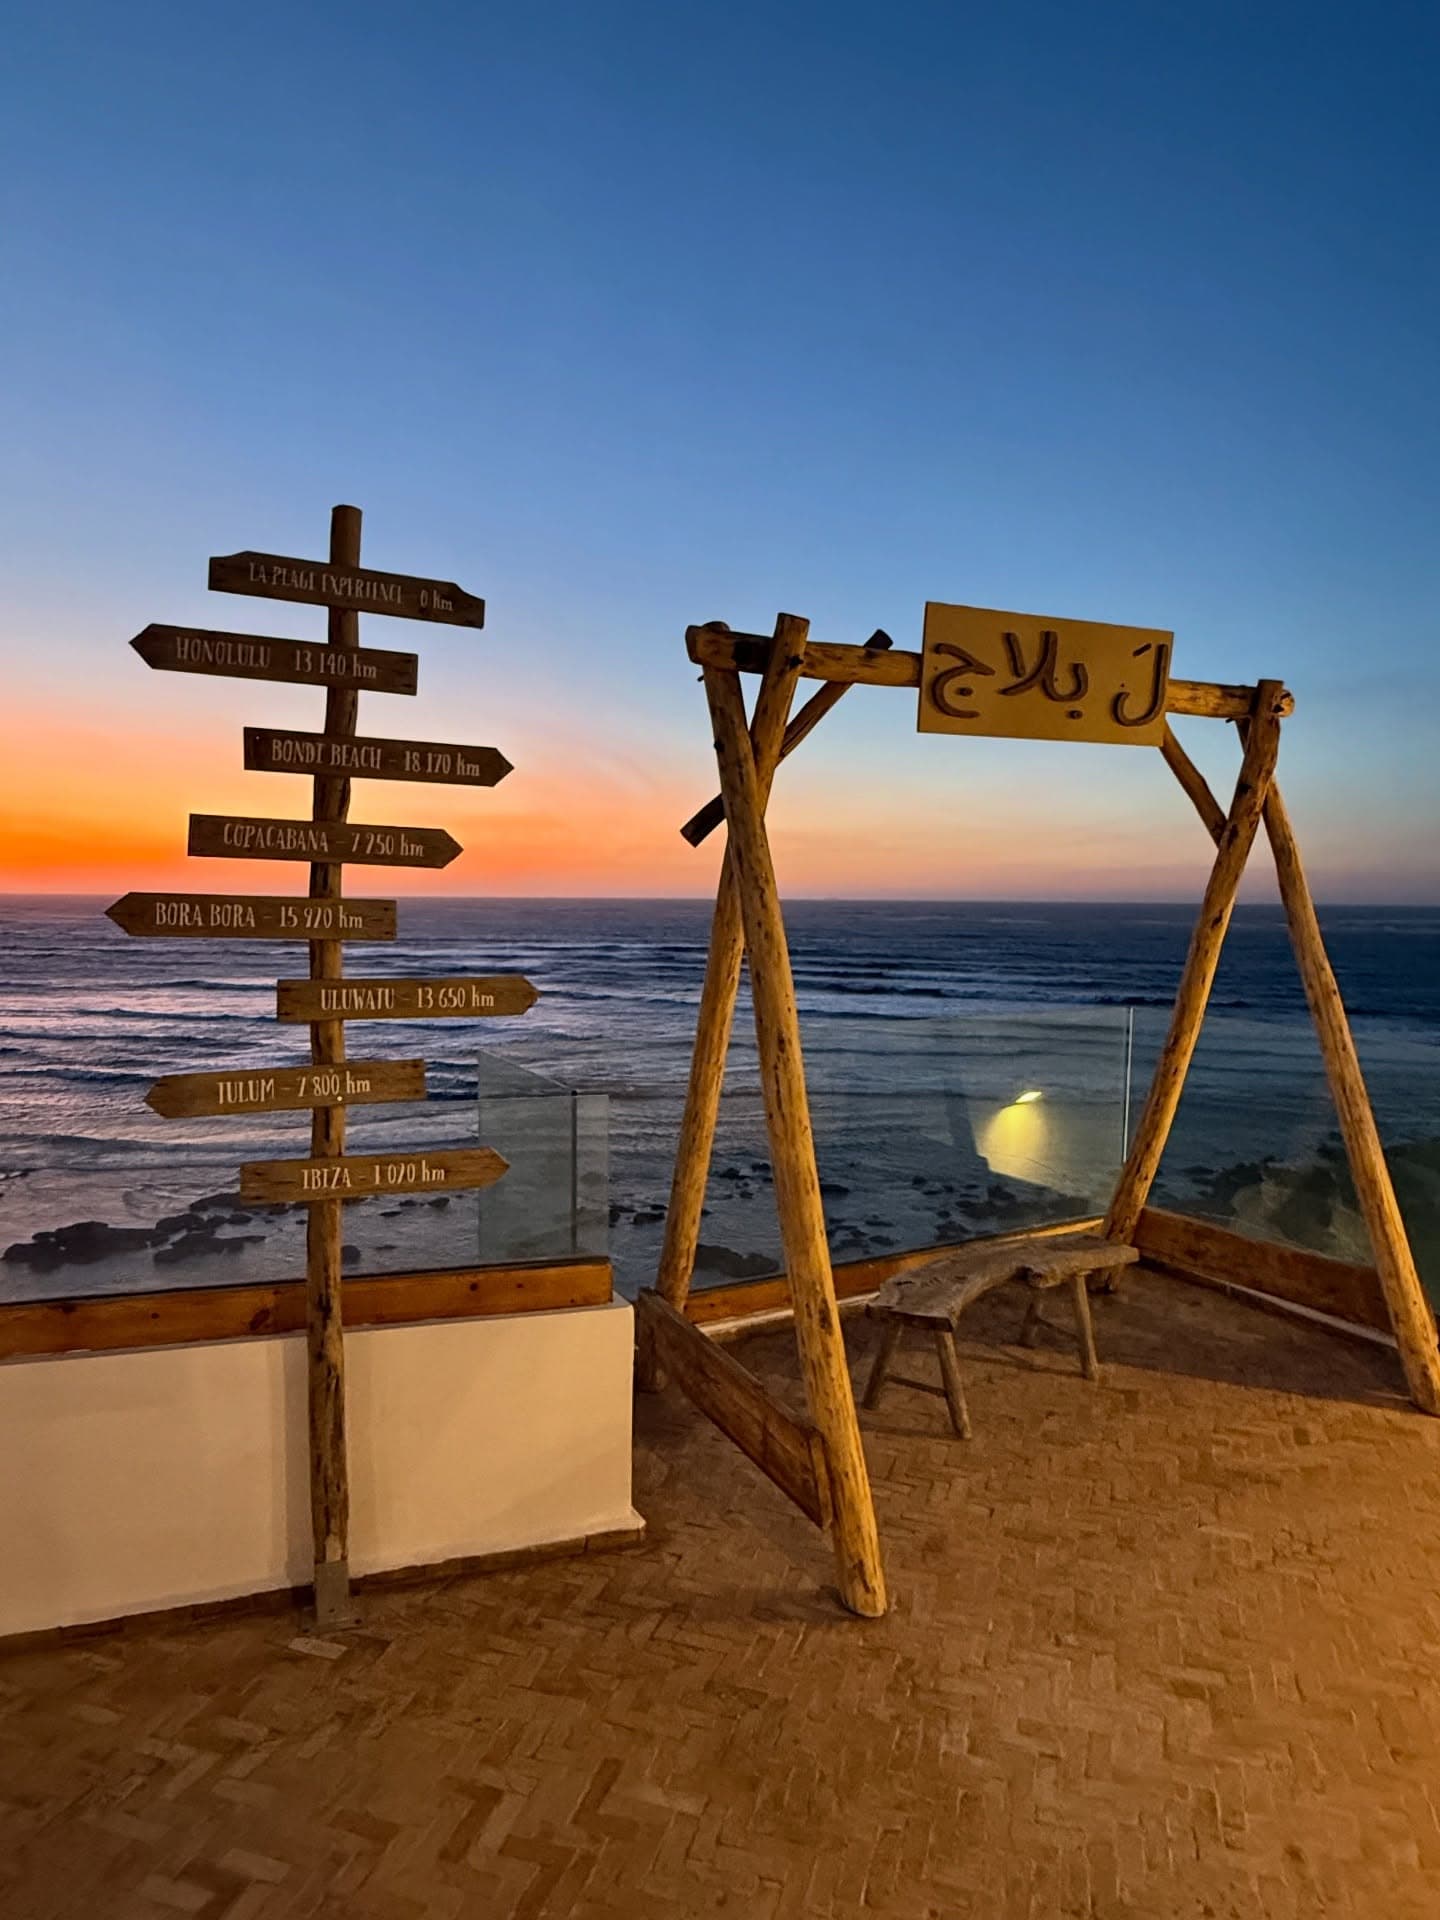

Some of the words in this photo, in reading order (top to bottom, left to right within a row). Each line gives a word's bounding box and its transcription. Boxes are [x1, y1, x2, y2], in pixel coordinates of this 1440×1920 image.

[249, 562, 268, 584] LA
[420, 590, 428, 608] 0
[176, 637, 270, 668] HONOLULU
[296, 650, 312, 672] 13
[320, 652, 346, 676] 140
[931, 631, 1088, 720] بلاج
[272, 739, 325, 764] BONDI
[330, 744, 381, 769] BEACH
[405, 751, 420, 772] 18
[426, 753, 451, 775] 170
[224, 823, 329, 853] COPACABANA
[156, 902, 203, 926] BORA
[210, 904, 255, 927] BORA
[280, 906, 297, 927] 15
[321, 988, 395, 1010] ULUWATU
[418, 988, 433, 1009] 13
[439, 987, 465, 1008] 650
[217, 1079, 275, 1104] TULUM
[313, 1075, 339, 1096] 800
[301, 1167, 351, 1190] IBIZA
[374, 1165, 380, 1185] 1
